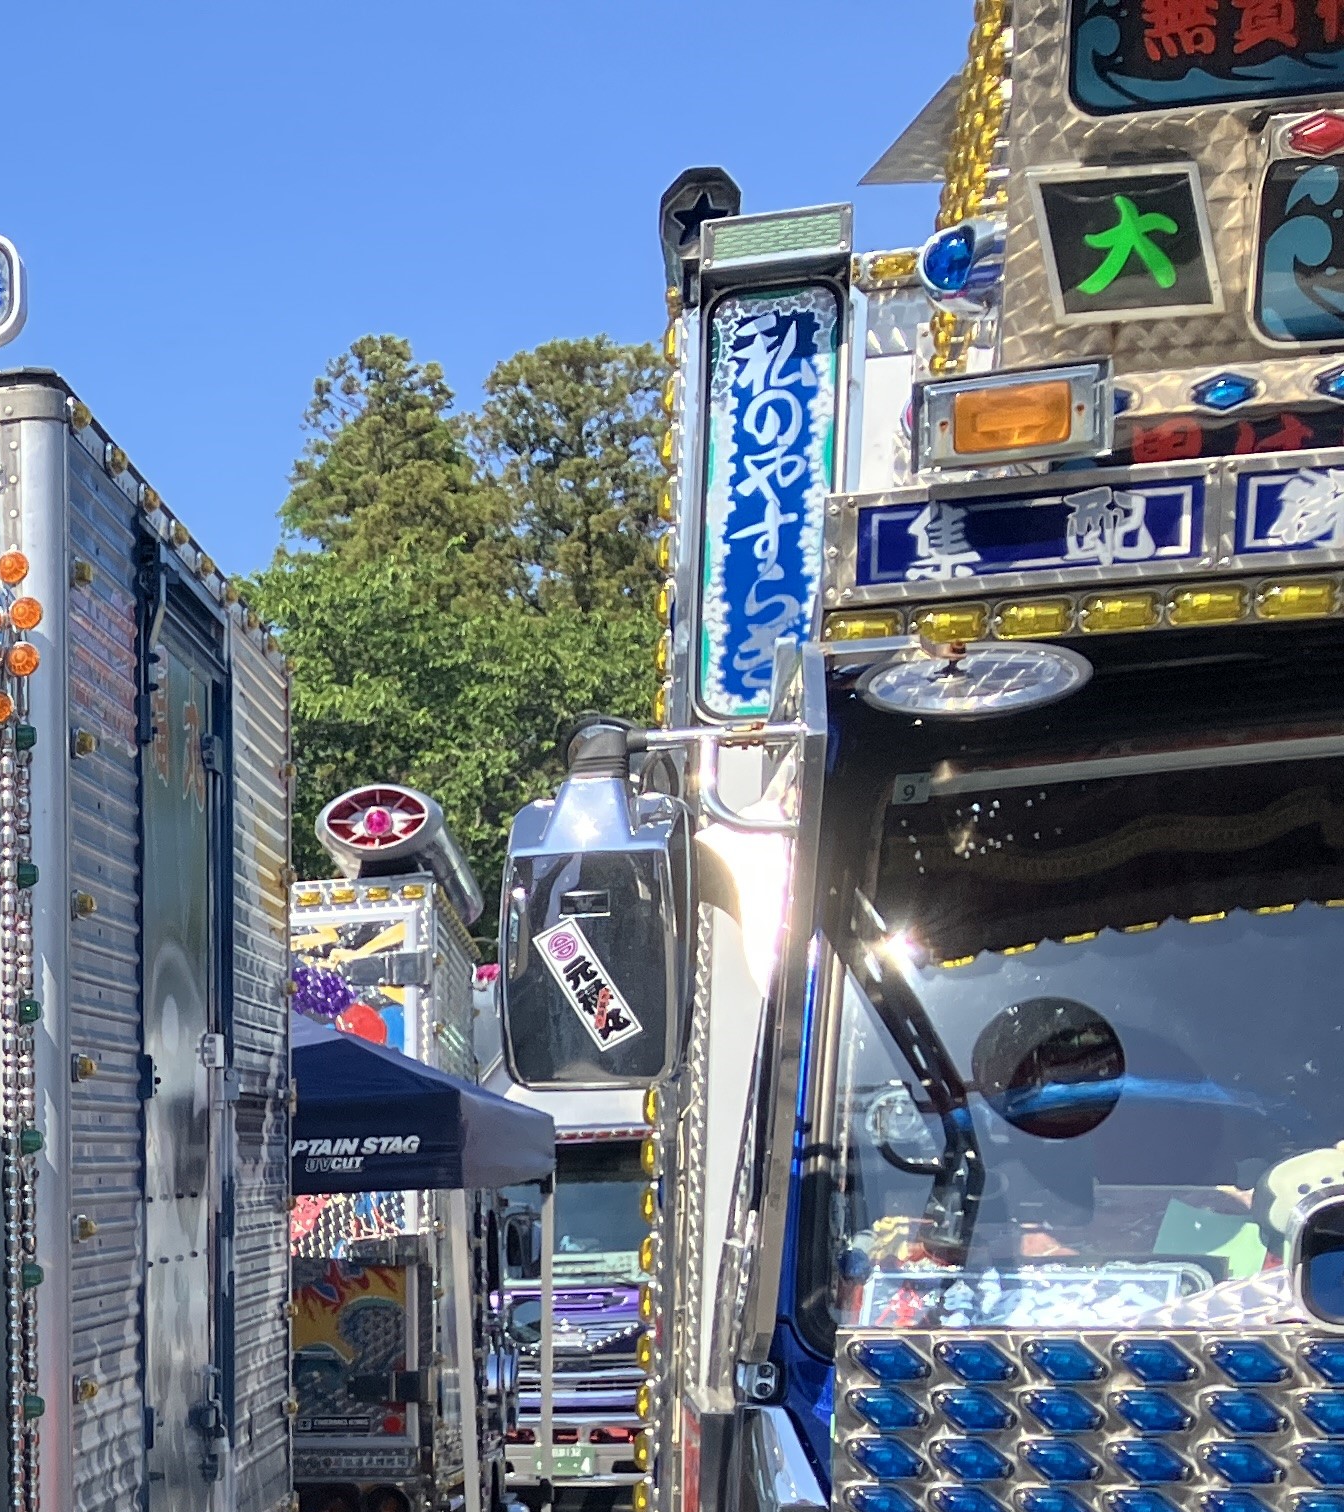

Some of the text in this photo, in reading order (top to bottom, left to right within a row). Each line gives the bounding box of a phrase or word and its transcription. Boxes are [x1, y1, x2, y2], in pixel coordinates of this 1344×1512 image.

[1077, 195, 1178, 294] 大
[905, 486, 1156, 581] 集配
[360, 1134, 421, 1156] STAG
